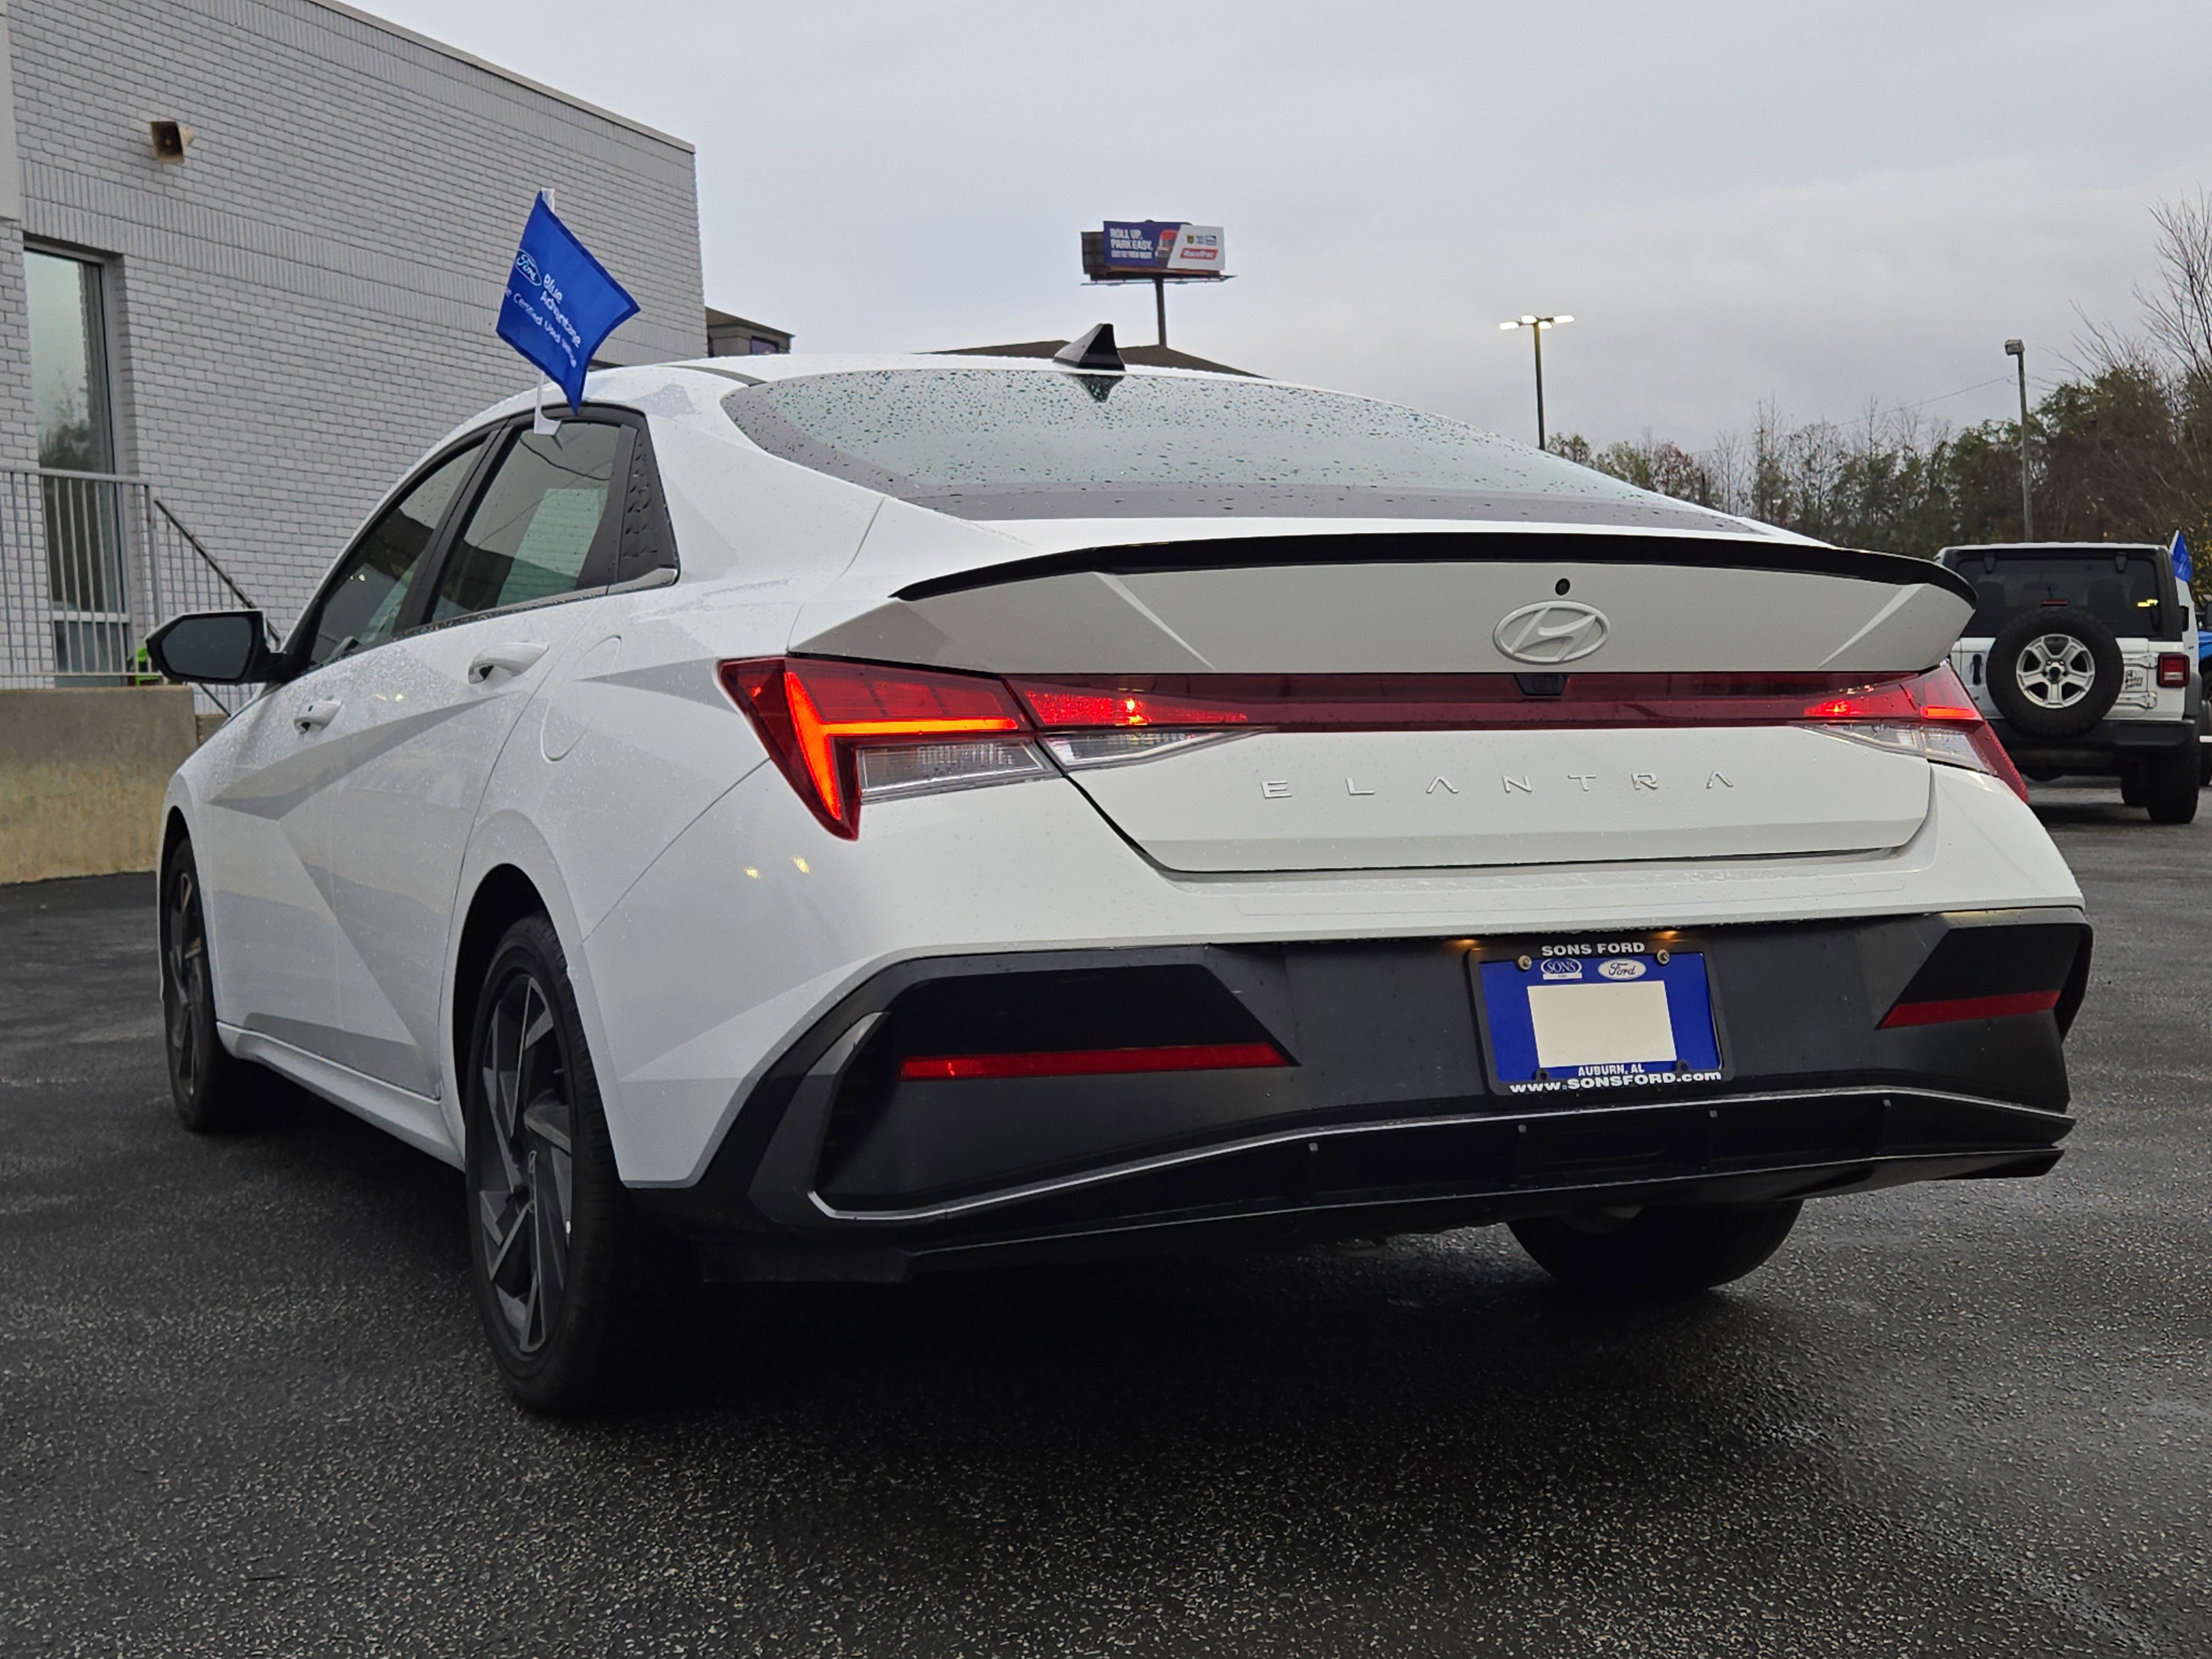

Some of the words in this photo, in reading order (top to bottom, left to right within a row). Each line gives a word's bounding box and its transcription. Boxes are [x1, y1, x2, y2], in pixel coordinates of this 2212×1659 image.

[544, 273, 563, 304] Blue
[541, 291, 581, 348] Advantage
[1261, 771, 1734, 800] ELANTRA
[1541, 943, 1592, 956] SONS
[1597, 942, 1645, 954] FORD
[1608, 962, 1636, 976] Ford
[1631, 1063, 1645, 1073] AL
[1509, 1071, 1721, 1093] www.SONSFORD.com
